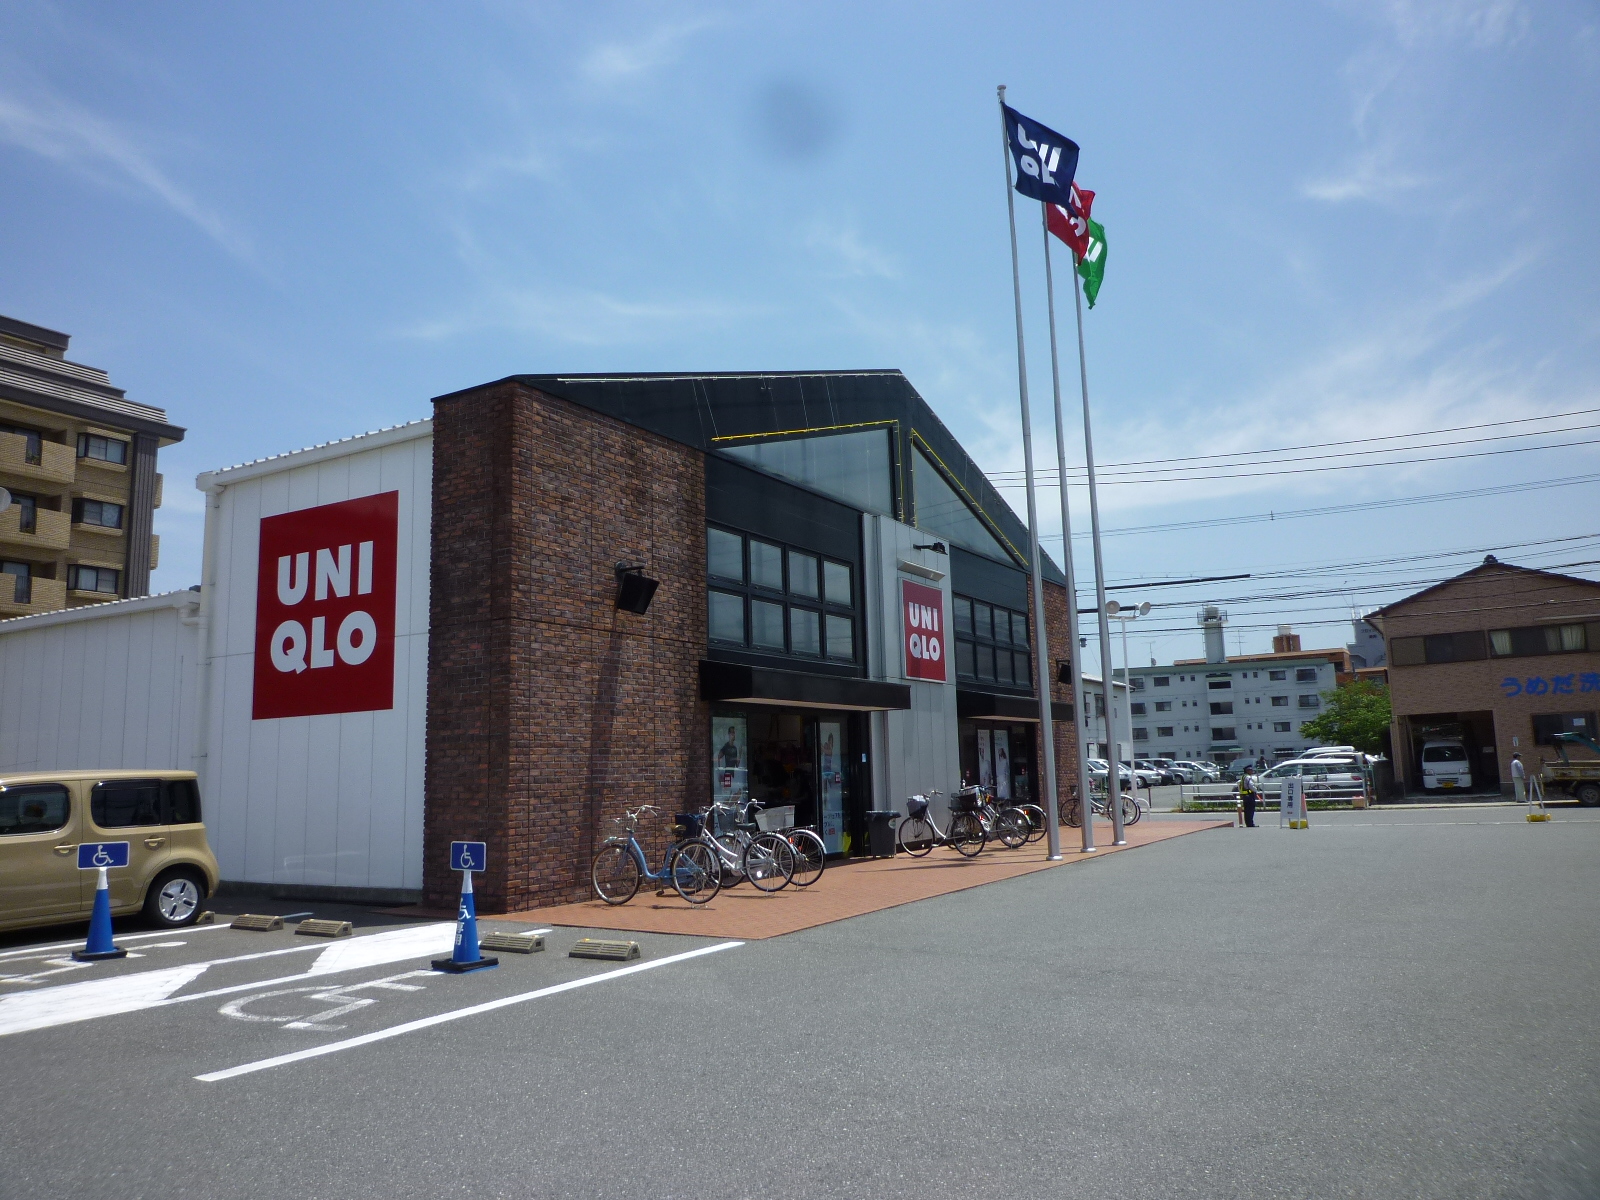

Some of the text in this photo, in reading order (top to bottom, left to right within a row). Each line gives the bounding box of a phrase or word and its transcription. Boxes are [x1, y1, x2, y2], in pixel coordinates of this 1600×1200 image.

[277, 540, 374, 606] UNI
[908, 601, 938, 632] UNI
[270, 610, 377, 675] QLO
[909, 633, 941, 661] QLO
